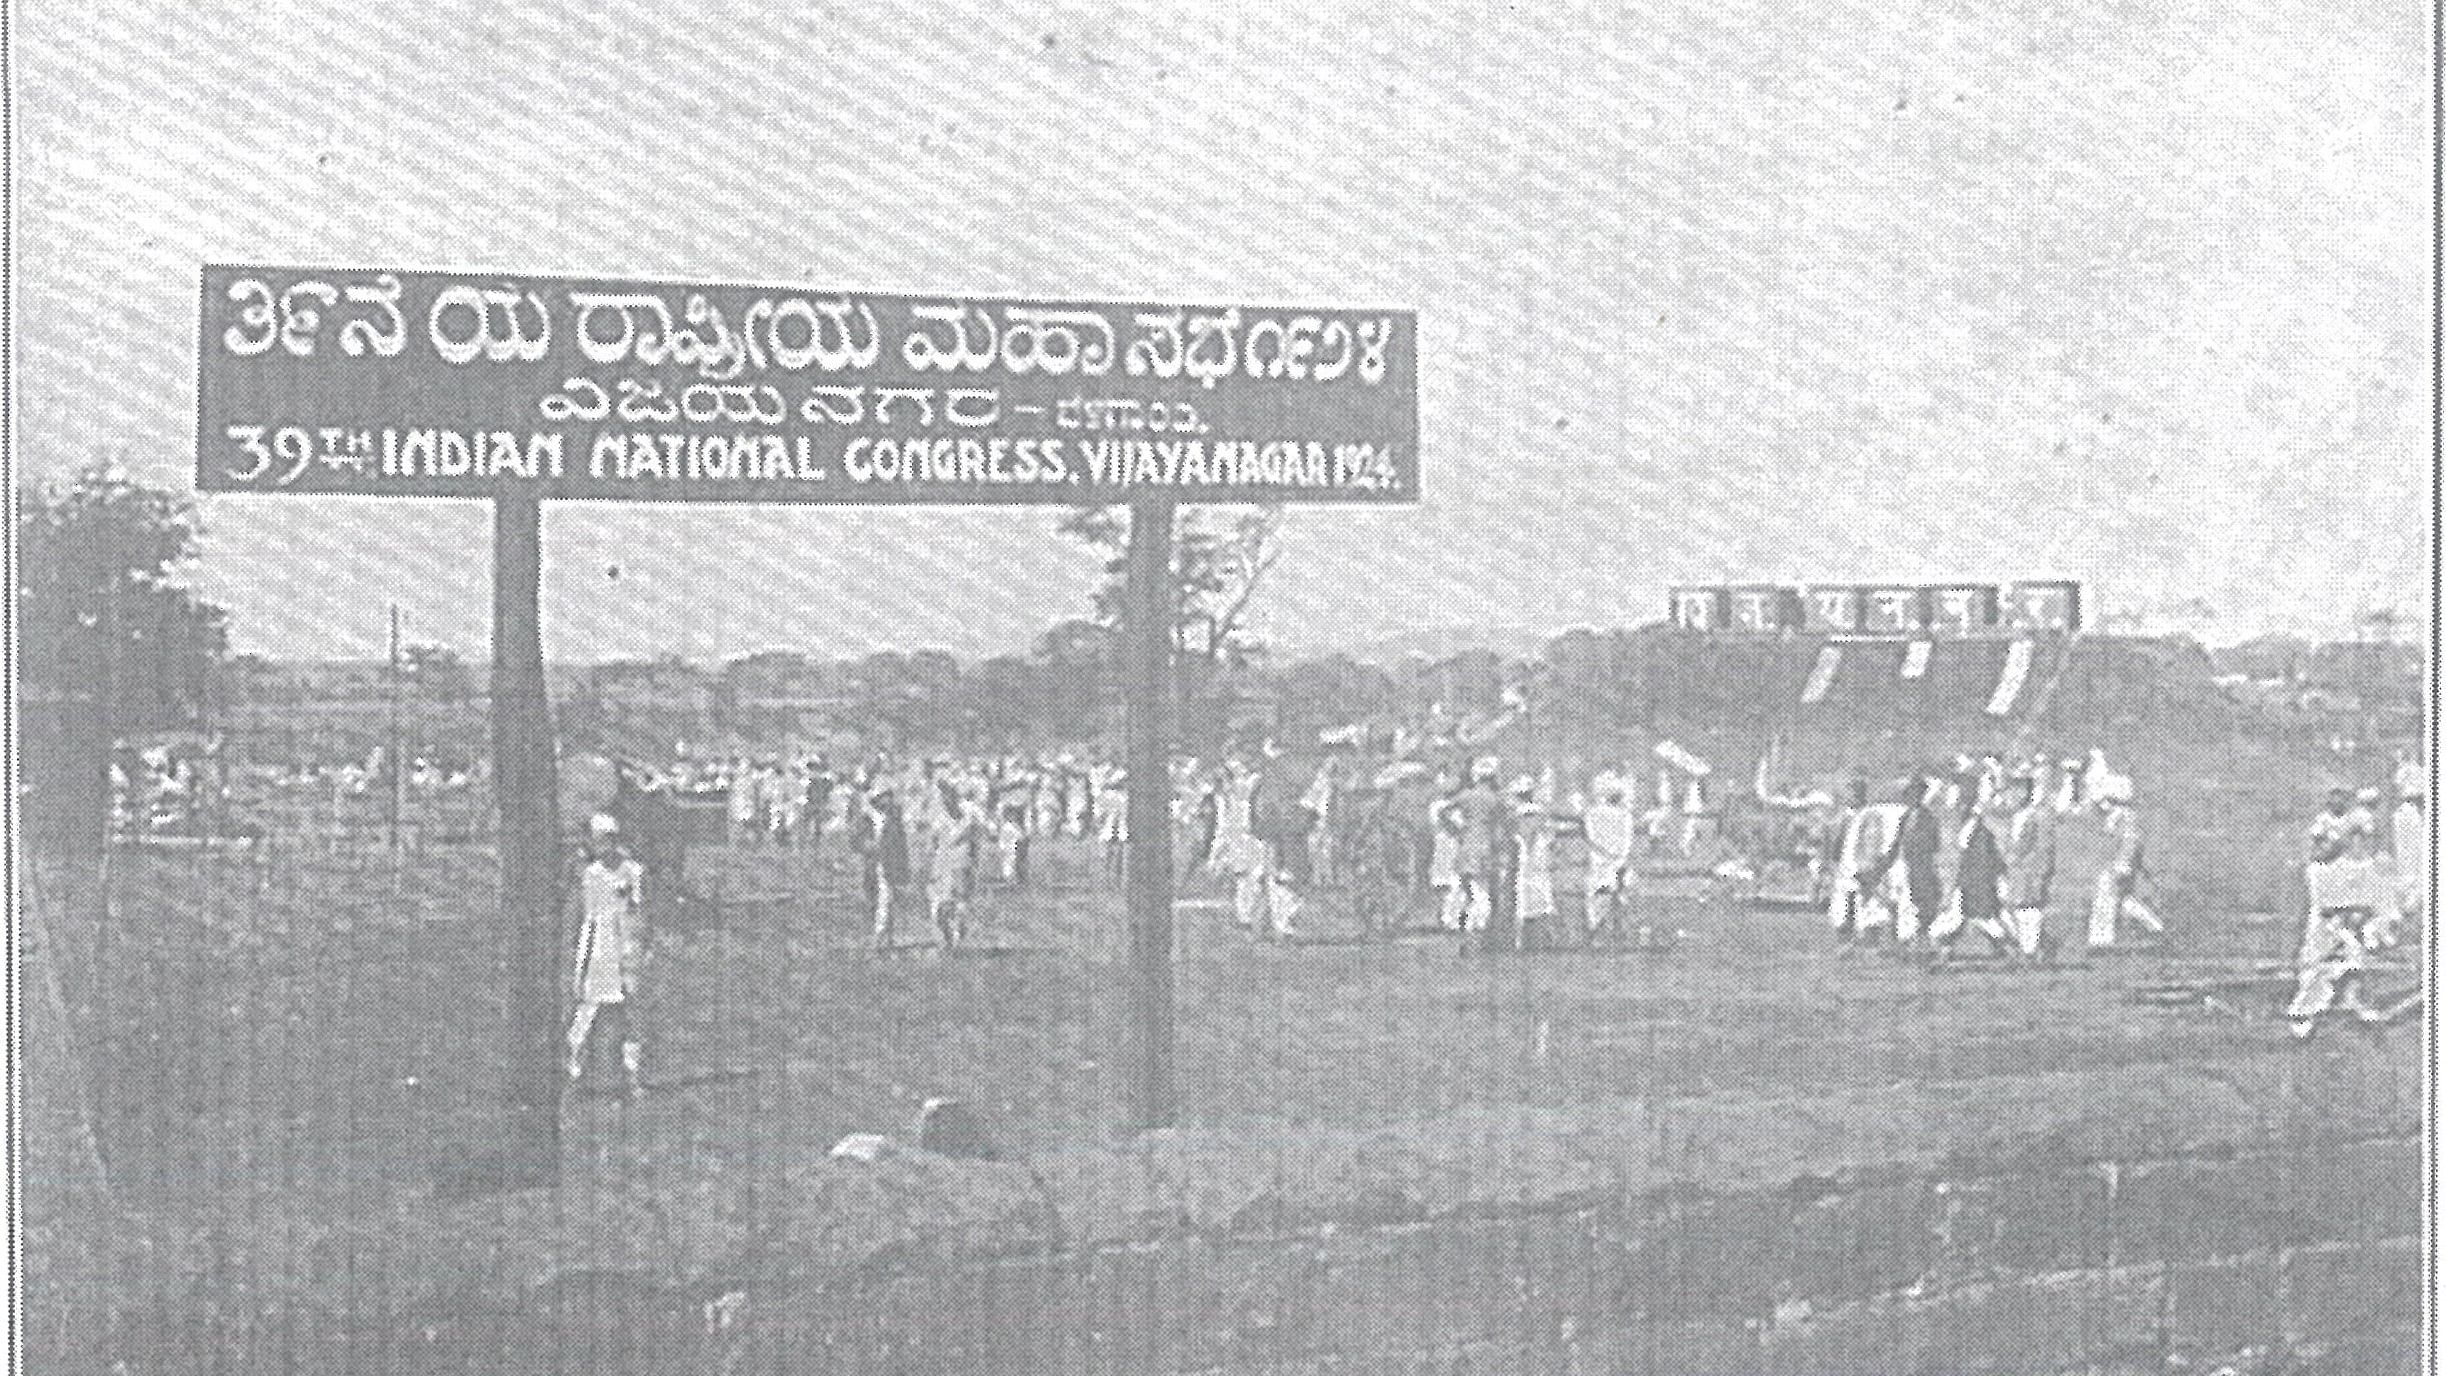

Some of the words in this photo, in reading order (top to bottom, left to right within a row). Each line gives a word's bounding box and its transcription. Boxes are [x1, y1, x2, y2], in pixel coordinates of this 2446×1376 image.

[383, 429, 563, 478] INDIAN
[590, 433, 826, 480] NATIONAL
[1080, 438, 1328, 488] VIJAYANAGAR
